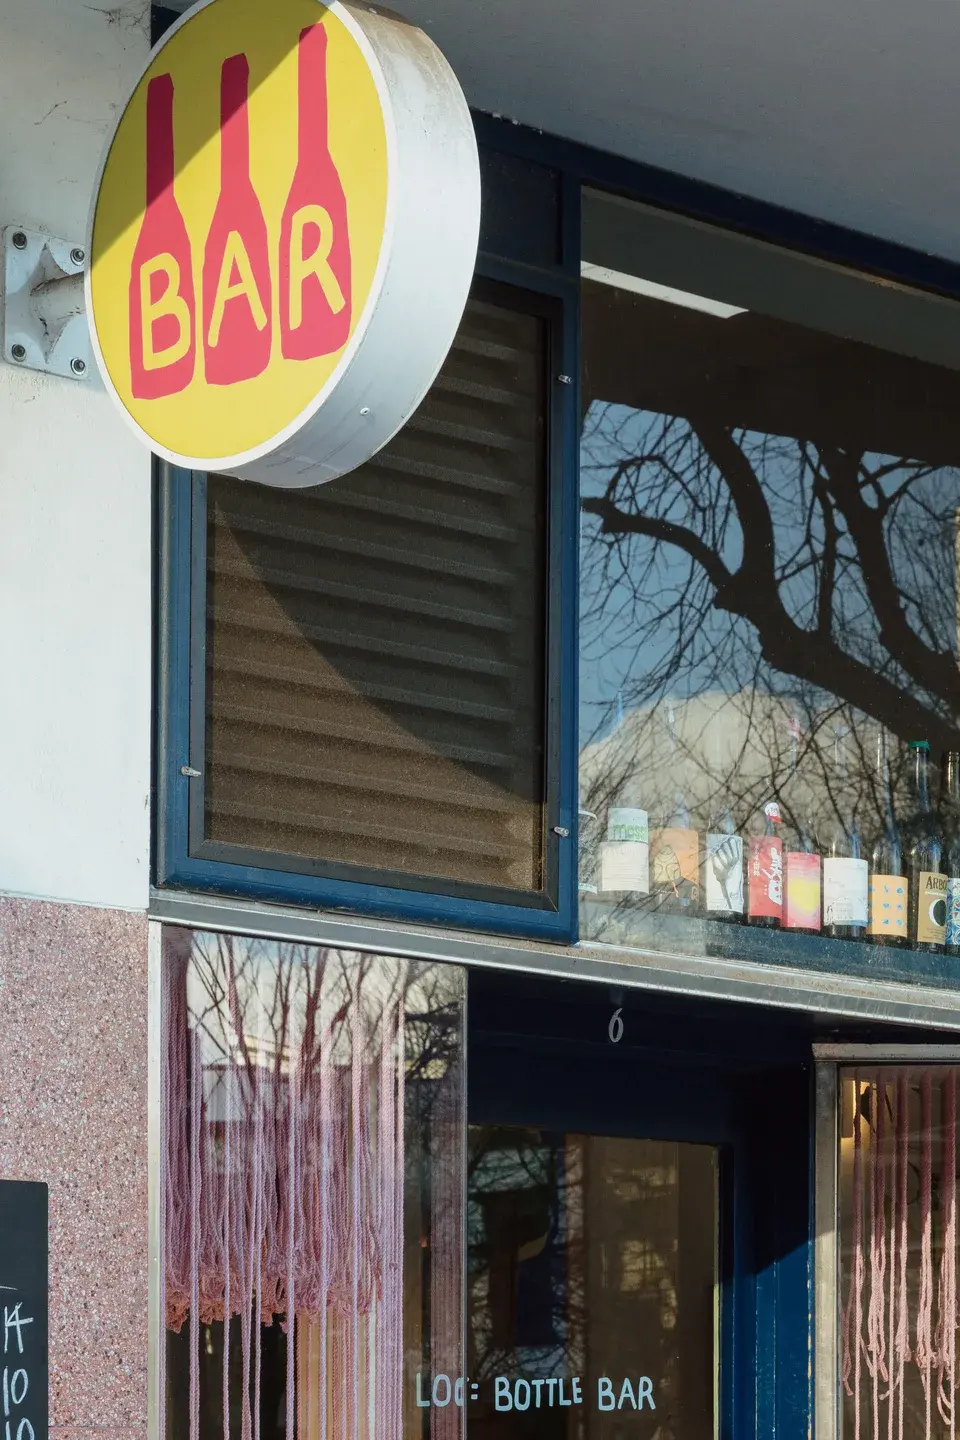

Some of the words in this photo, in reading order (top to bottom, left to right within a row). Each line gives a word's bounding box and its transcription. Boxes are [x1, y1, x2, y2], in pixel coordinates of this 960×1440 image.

[140, 204, 346, 371] BAR
[608, 1007, 624, 1043] 6
[4, 1365, 29, 1417] 10
[494, 1376, 583, 1412] BOTTLE
[598, 1376, 656, 1411] BAR
